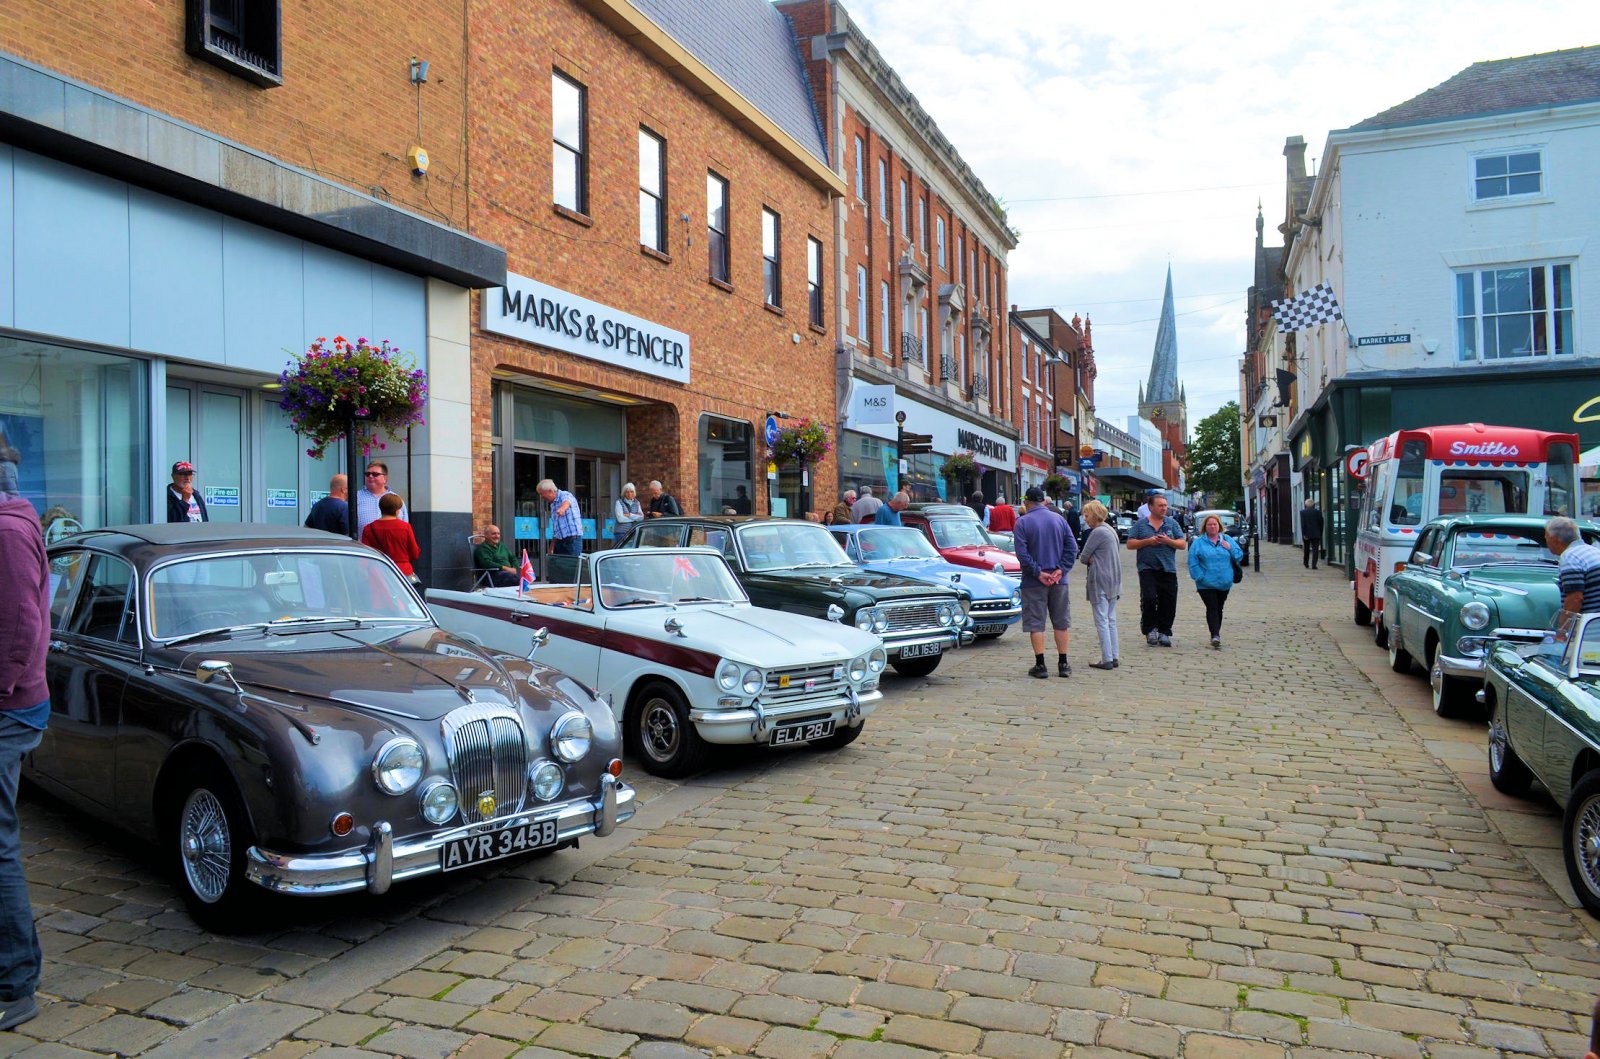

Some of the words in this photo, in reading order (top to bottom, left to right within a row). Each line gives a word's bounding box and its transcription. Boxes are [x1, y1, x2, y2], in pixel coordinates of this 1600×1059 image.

[502, 287, 582, 338] MARKS
[585, 314, 599, 344] &
[602, 319, 684, 369] SPENCER
[1360, 337, 1386, 345] MARKET
[1388, 335, 1408, 343] PLACE
[864, 397, 887, 407] M&S
[1450, 441, 1519, 456] Smiths
[213, 488, 226, 496] Fire
[226, 488, 237, 496] exit
[275, 490, 286, 498] Fire
[213, 497, 226, 505] Keep
[275, 498, 286, 506] Keep
[903, 646, 920, 658] BJA
[921, 644, 939, 656] 163B
[775, 726, 802, 744] ELA
[805, 722, 831, 740] 28J
[447, 834, 493, 867] AYR
[498, 821, 556, 854] 345B
